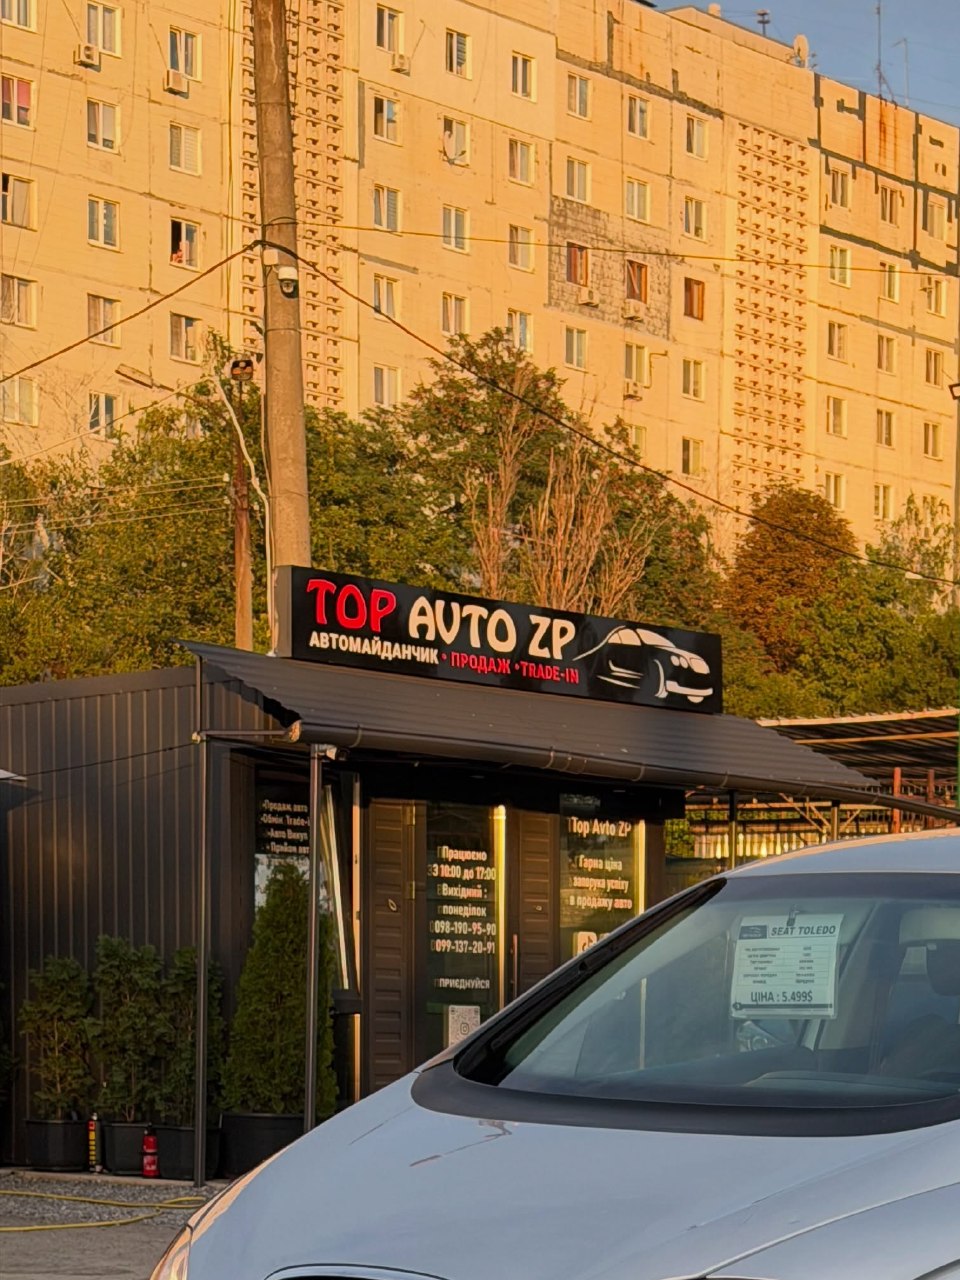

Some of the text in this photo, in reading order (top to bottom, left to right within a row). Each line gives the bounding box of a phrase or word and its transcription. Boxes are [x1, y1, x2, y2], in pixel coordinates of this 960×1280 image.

[307, 579, 576, 660] TOP AVTO ZP
[309, 631, 579, 684] АВТОМАЙДАНЧИК ПРОДАЖ TRADE-IN
[286, 814, 310, 827] Trade-I
[570, 816, 632, 838] Top Avto ZP
[441, 845, 487, 862] Працюємо
[578, 854, 623, 872] Гарна ціна
[440, 864, 462, 878] 10:00
[462, 868, 474, 880] до
[475, 866, 497, 880] 17:00
[441, 883, 483, 899] Вихідний
[442, 903, 487, 918] понеділок
[576, 895, 614, 911] продажу
[613, 898, 633, 910] авто
[434, 920, 497, 936] 098-190-95-90
[771, 926, 796, 936] SEAT
[798, 925, 837, 935] TOLEDO
[435, 939, 496, 954] 099-137-20-91
[439, 977, 490, 990] ПРИЄДНУЙСЯ
[750, 991, 775, 1003] ЦІНА
[781, 990, 813, 1003] 5.499$
